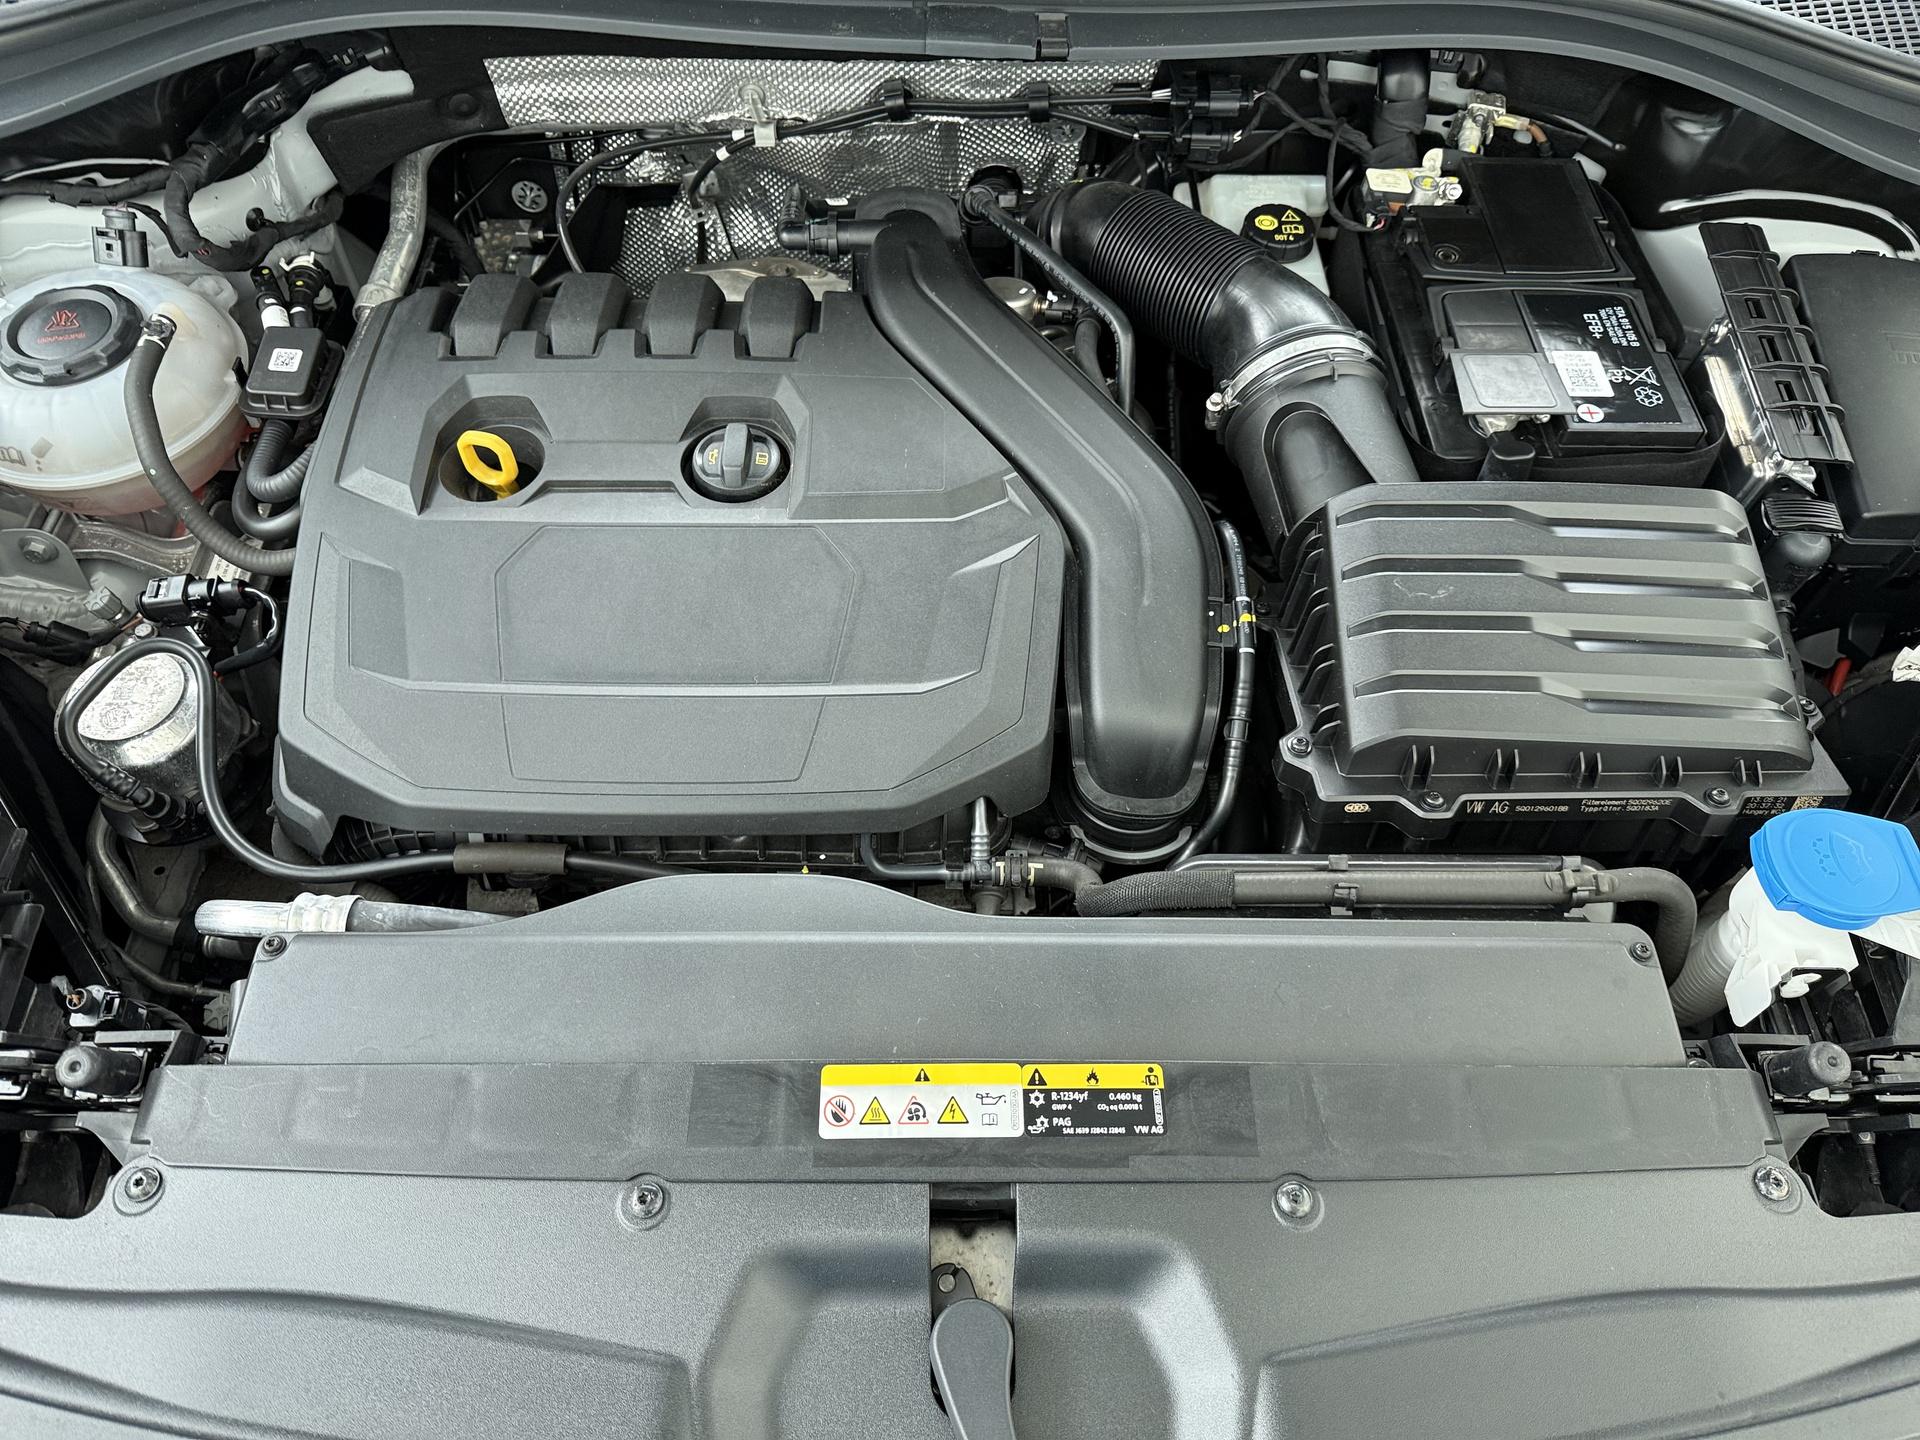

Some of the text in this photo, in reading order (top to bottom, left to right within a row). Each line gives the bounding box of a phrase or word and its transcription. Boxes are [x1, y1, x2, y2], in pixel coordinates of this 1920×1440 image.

[1613, 306, 1626, 318] 5TA
[1583, 313, 1604, 340] EFB+
[1619, 318, 1633, 330] 915
[1624, 330, 1638, 341] 105
[1607, 369, 1623, 383] Pb
[1466, 801, 1486, 814] VW
[1489, 801, 1510, 814] AG
[1051, 1091, 1142, 1103] R-1234yf 0.460 kg
[1109, 1104, 1118, 1112] eq
[1052, 1117, 1072, 1127] PAG
[1133, 1125, 1164, 1134] VW AG
